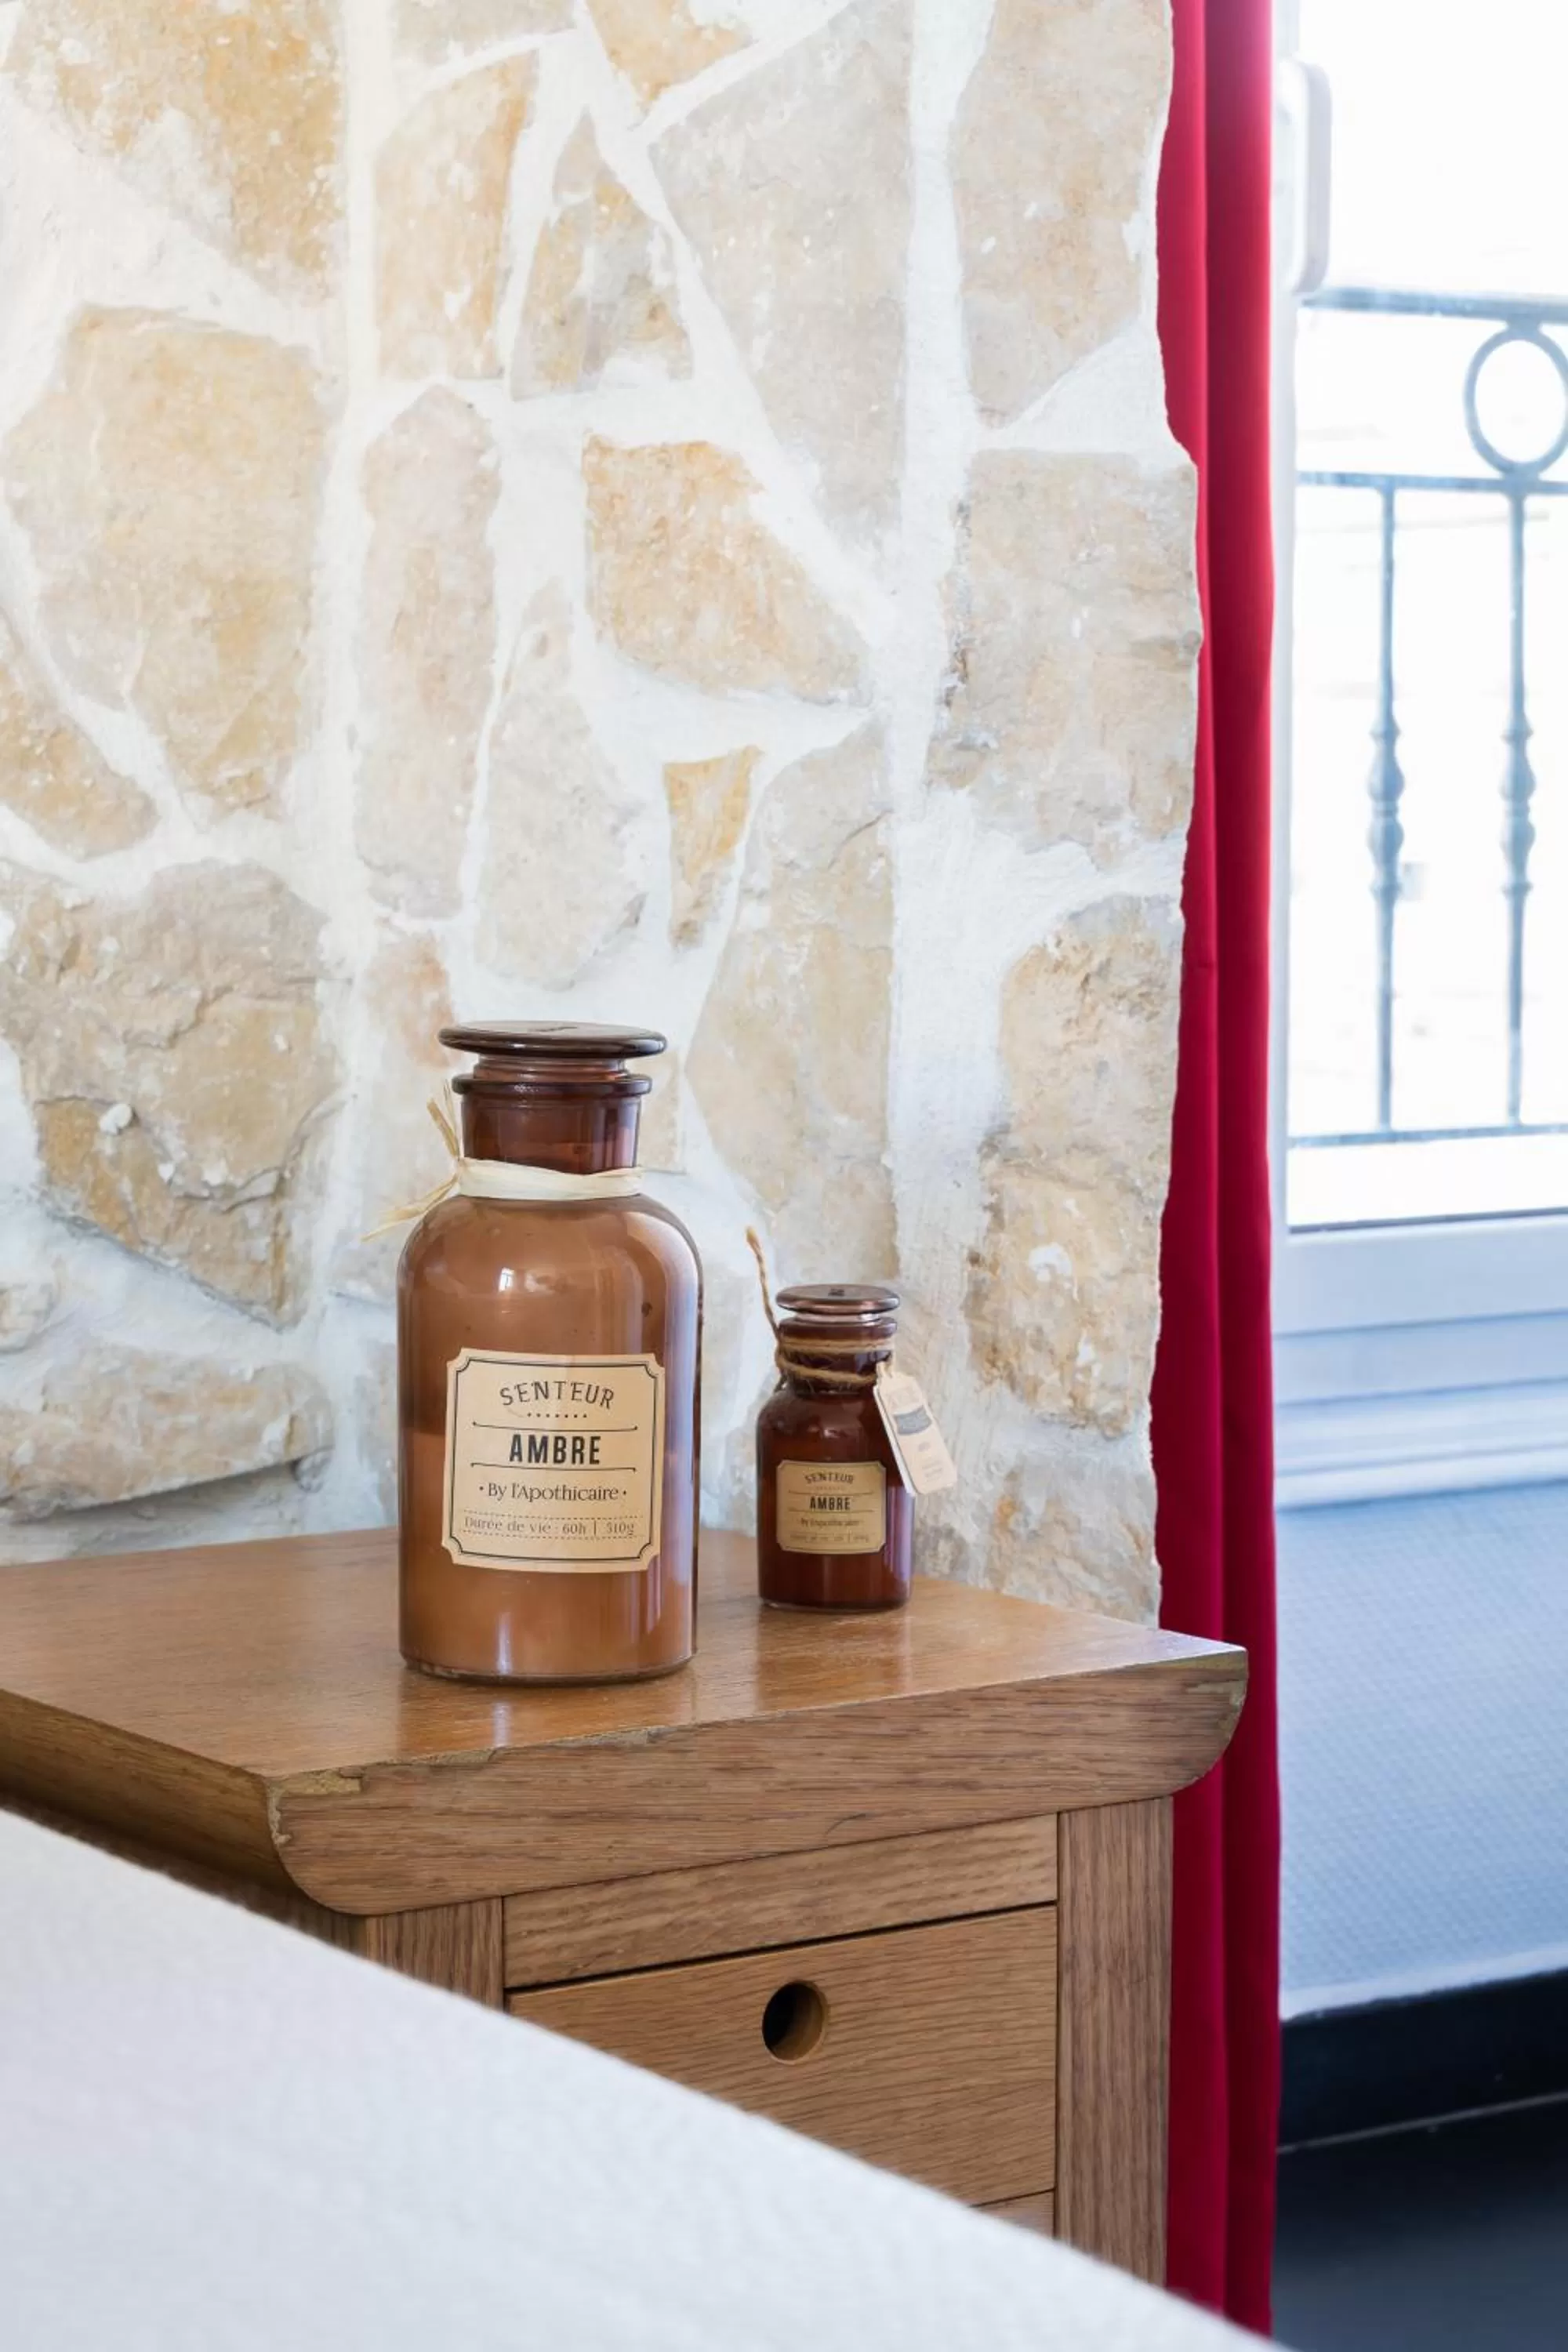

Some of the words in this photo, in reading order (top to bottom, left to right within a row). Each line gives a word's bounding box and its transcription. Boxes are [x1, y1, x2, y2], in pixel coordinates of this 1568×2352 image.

[499, 1381, 614, 1410] SENTEUR
[509, 1434, 601, 1465] AMBRE
[488, 1483, 508, 1501] By
[511, 1483, 619, 1503] l'Apothicaire
[810, 1497, 851, 1510] AMBRE
